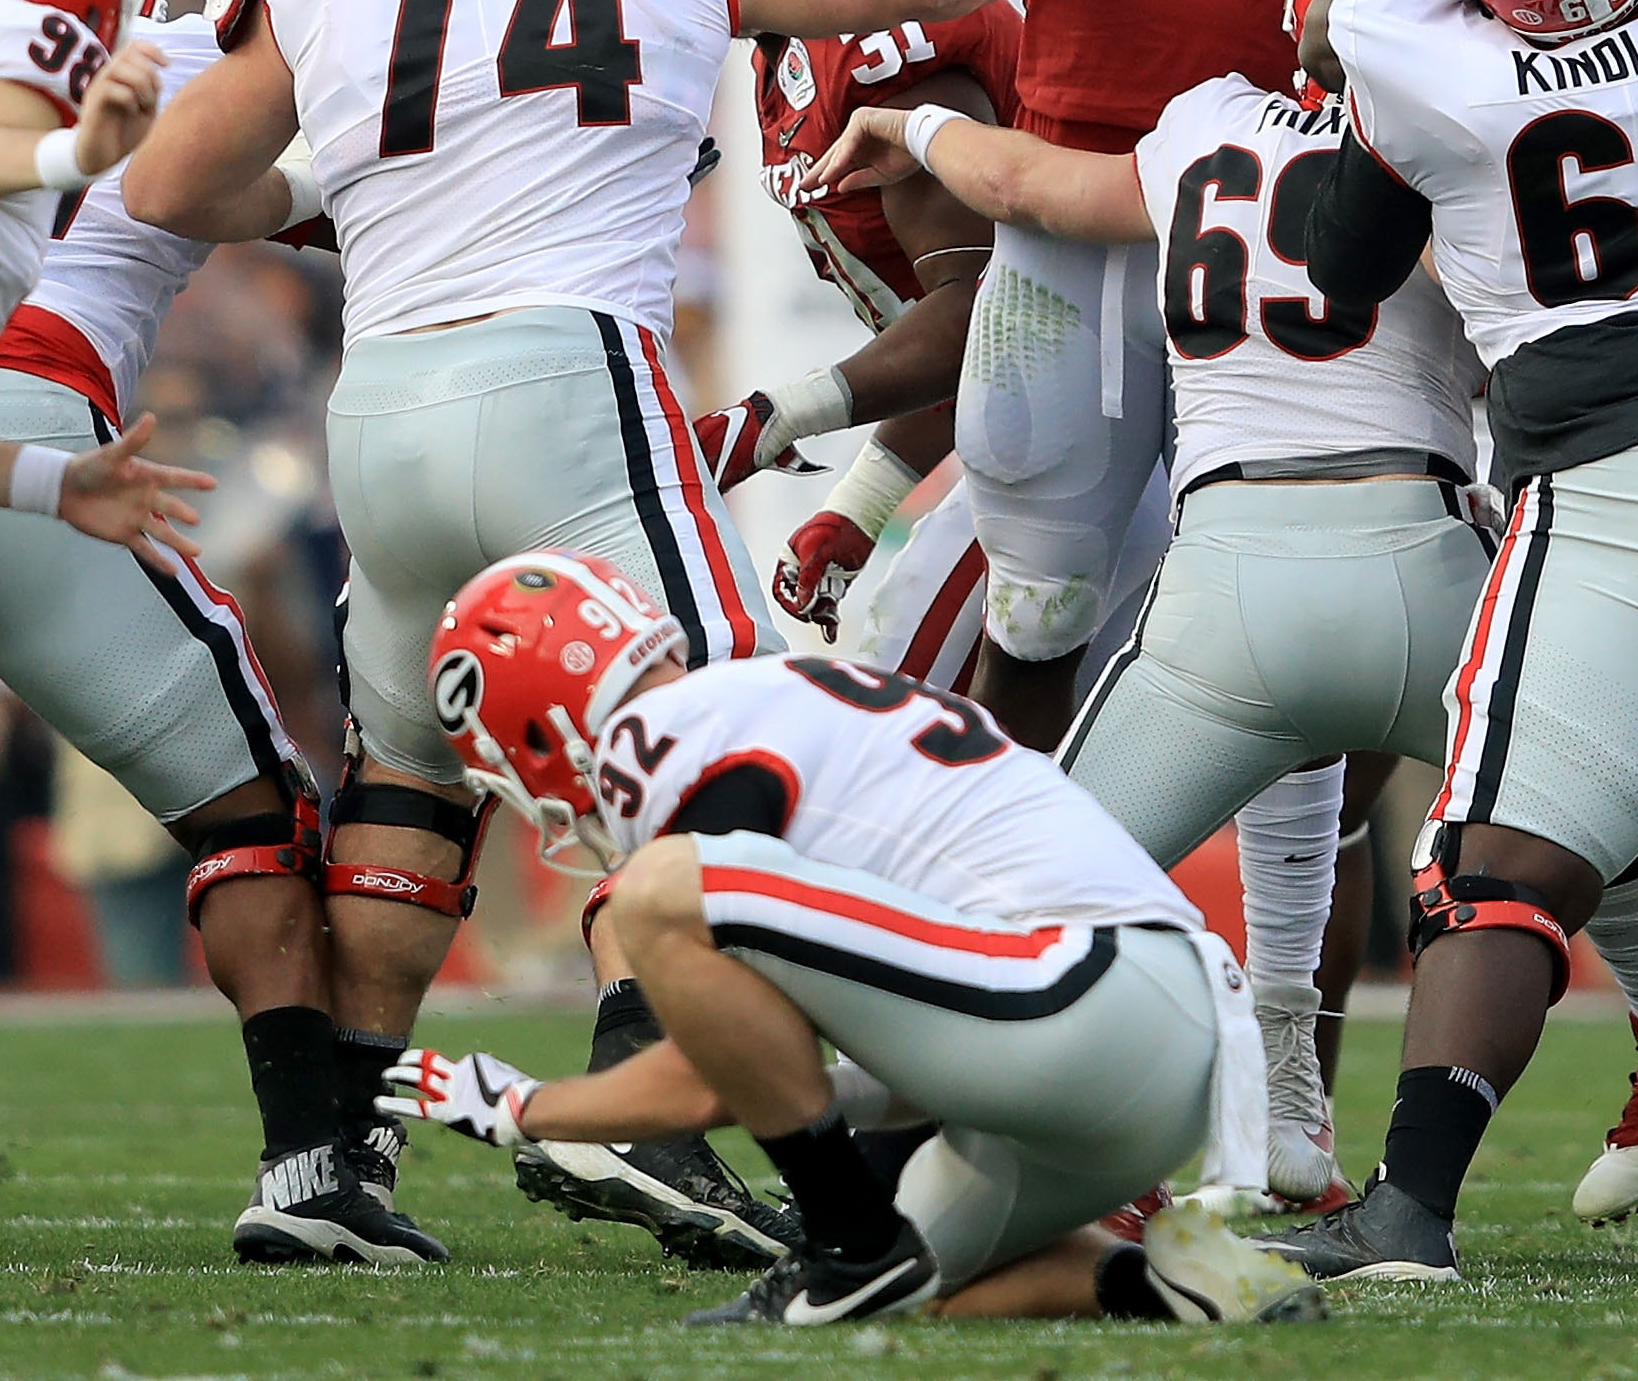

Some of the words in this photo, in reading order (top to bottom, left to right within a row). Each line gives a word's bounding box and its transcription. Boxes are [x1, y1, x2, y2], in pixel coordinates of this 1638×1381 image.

[1163, 142, 1379, 363] 69
[576, 576, 653, 642] 92
[599, 716, 678, 819] 92
[351, 872, 425, 894] DONJOY
[261, 1143, 340, 1212] NIKE
